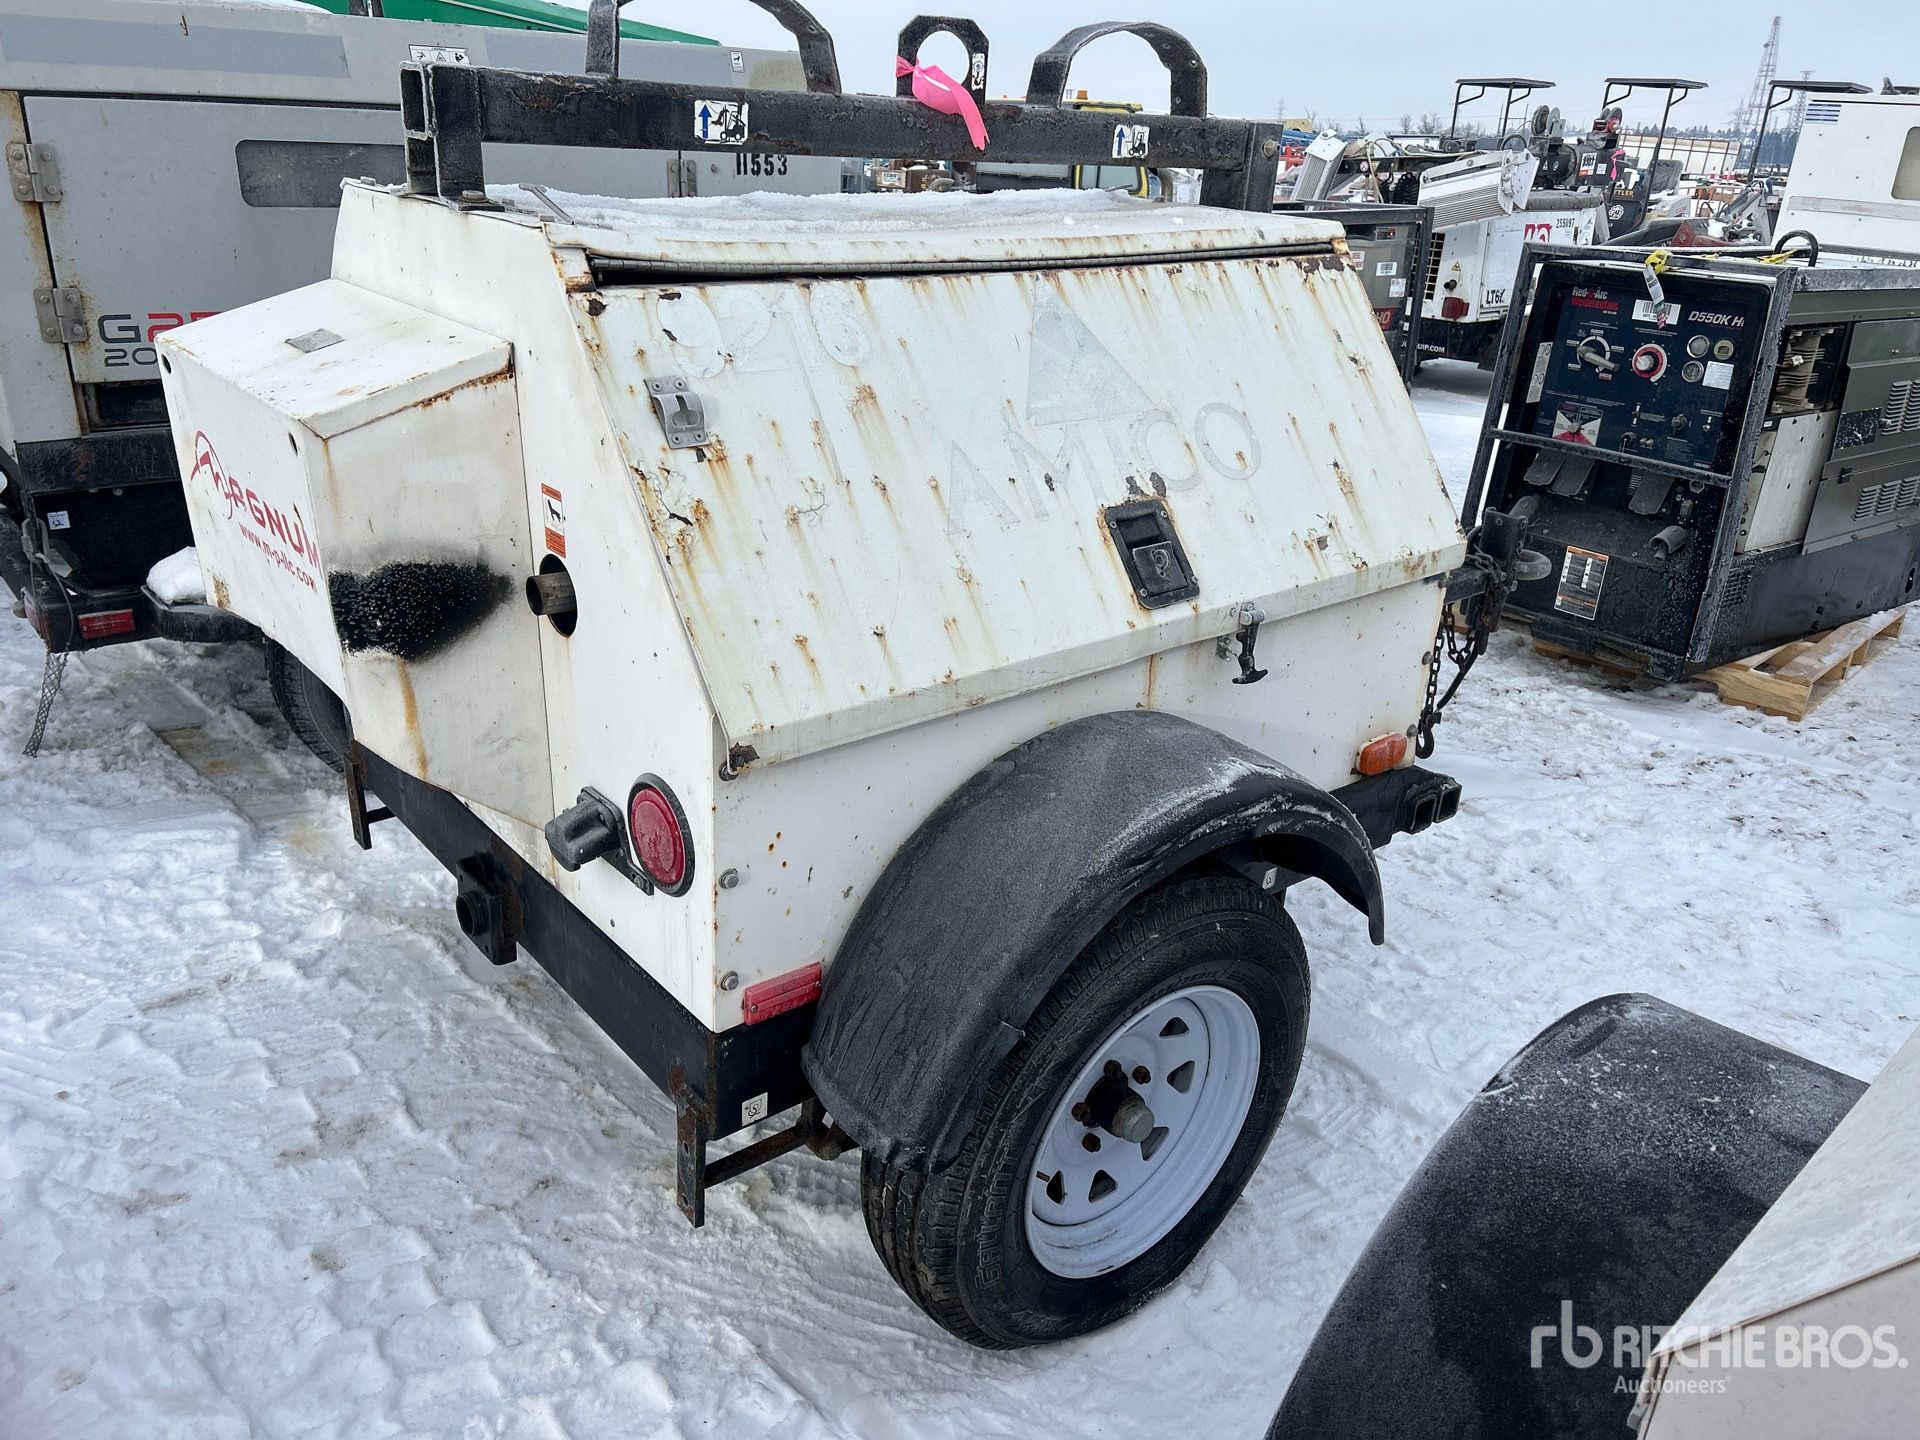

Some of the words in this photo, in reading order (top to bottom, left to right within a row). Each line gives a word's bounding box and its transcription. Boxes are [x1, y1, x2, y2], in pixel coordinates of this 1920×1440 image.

[97, 311, 224, 344] G2
[1688, 310, 1732, 326] D550K
[1731, 316, 1745, 327] H
